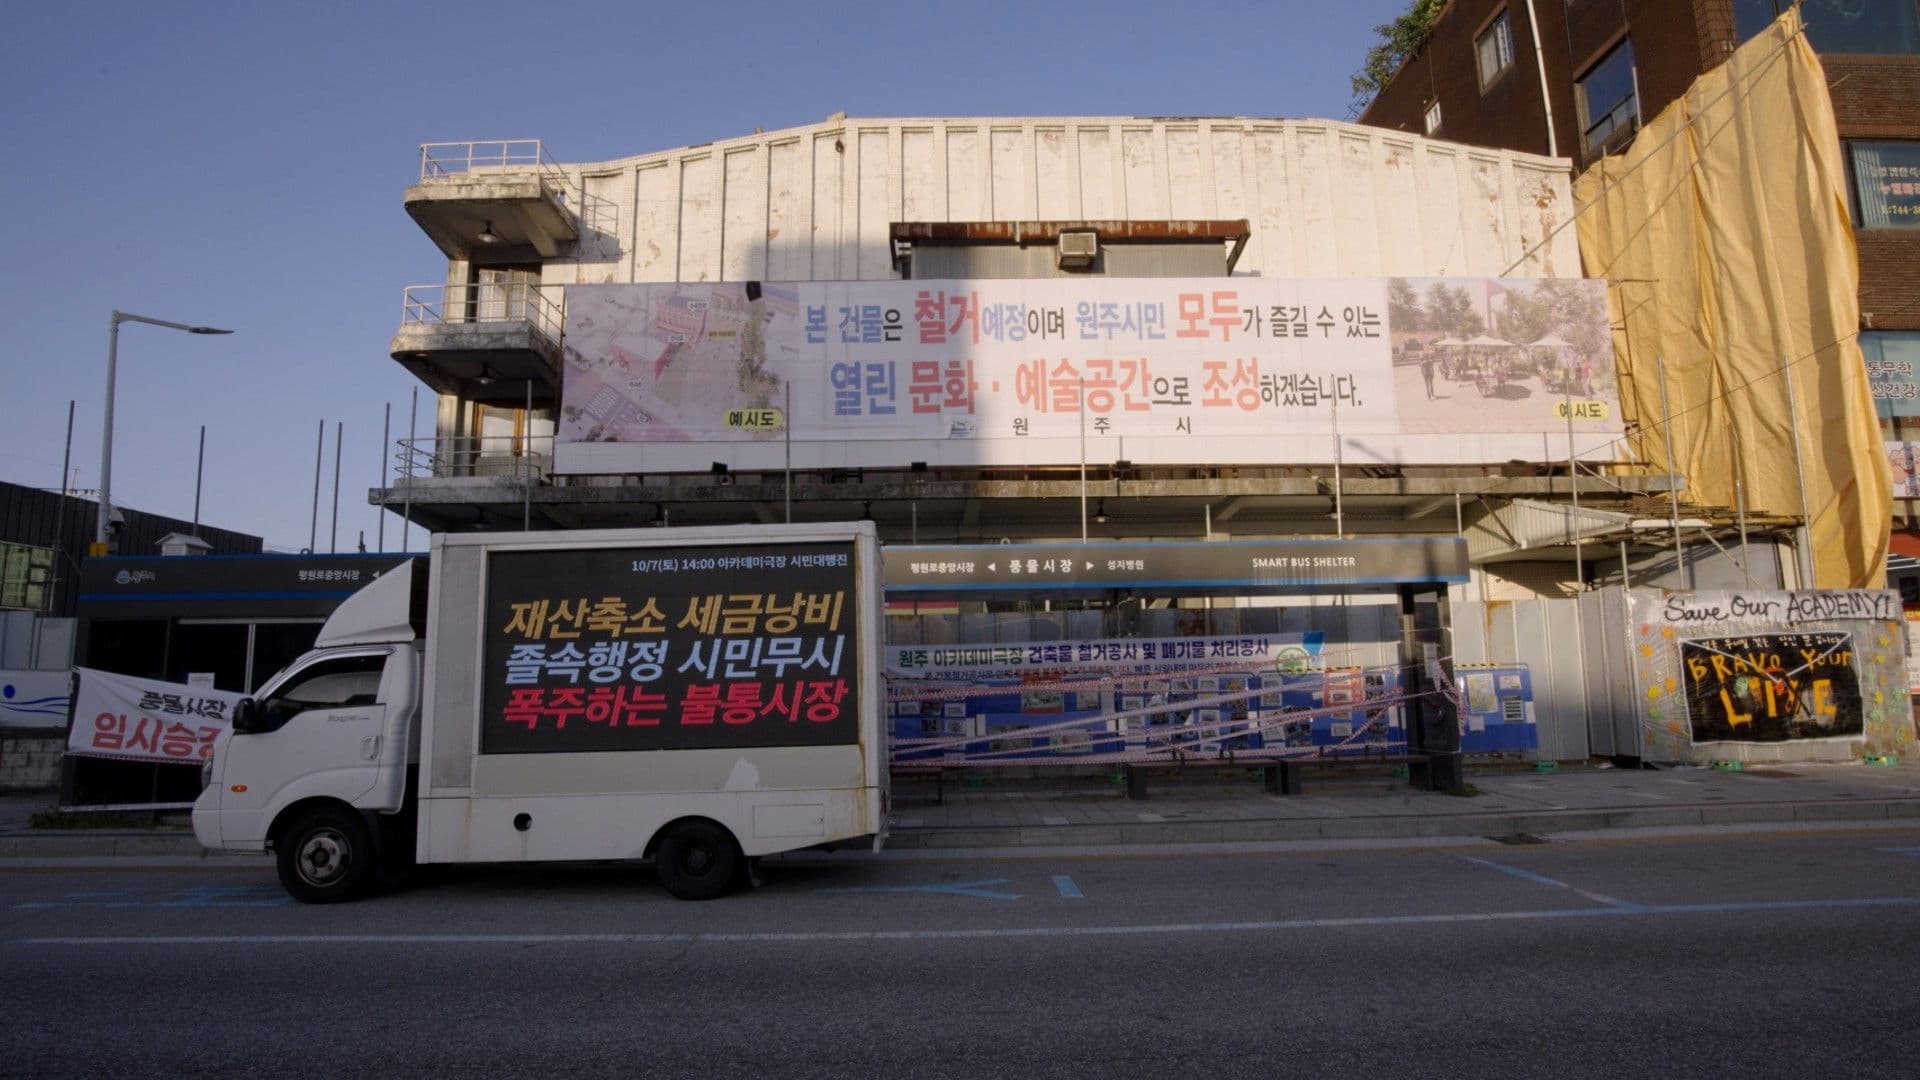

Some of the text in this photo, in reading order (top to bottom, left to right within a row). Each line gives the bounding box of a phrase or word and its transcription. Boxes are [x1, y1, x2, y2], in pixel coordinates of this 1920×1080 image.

[805, 290, 1381, 345] 본 건물은 철거예정이며 원주시민 모두가 즐길 수 있는
[830, 360, 897, 416] 열린
[908, 359, 979, 415] 문화
[1202, 356, 1363, 412] 조성하겠습니다.
[729, 411, 774, 427] 예시도
[631, 553, 849, 573] 10/7(토) 14:00 아카데미극장 시민대행진
[1106, 559, 1145, 571] 성지병원
[1252, 556, 1356, 568] SMART BUS SHELTER
[503, 591, 845, 640] 재산축소 세금낭비
[1664, 596, 1729, 622] Save
[1731, 595, 1780, 617] Our
[505, 634, 846, 685] 졸속행정 시민무시
[898, 638, 1270, 668] 원주 아카데미극장 건축물 철거공사 및 폐기물 처리공사
[138, 690, 228, 720] 풍물시장
[503, 679, 849, 729] 폭주하는 불통시장
